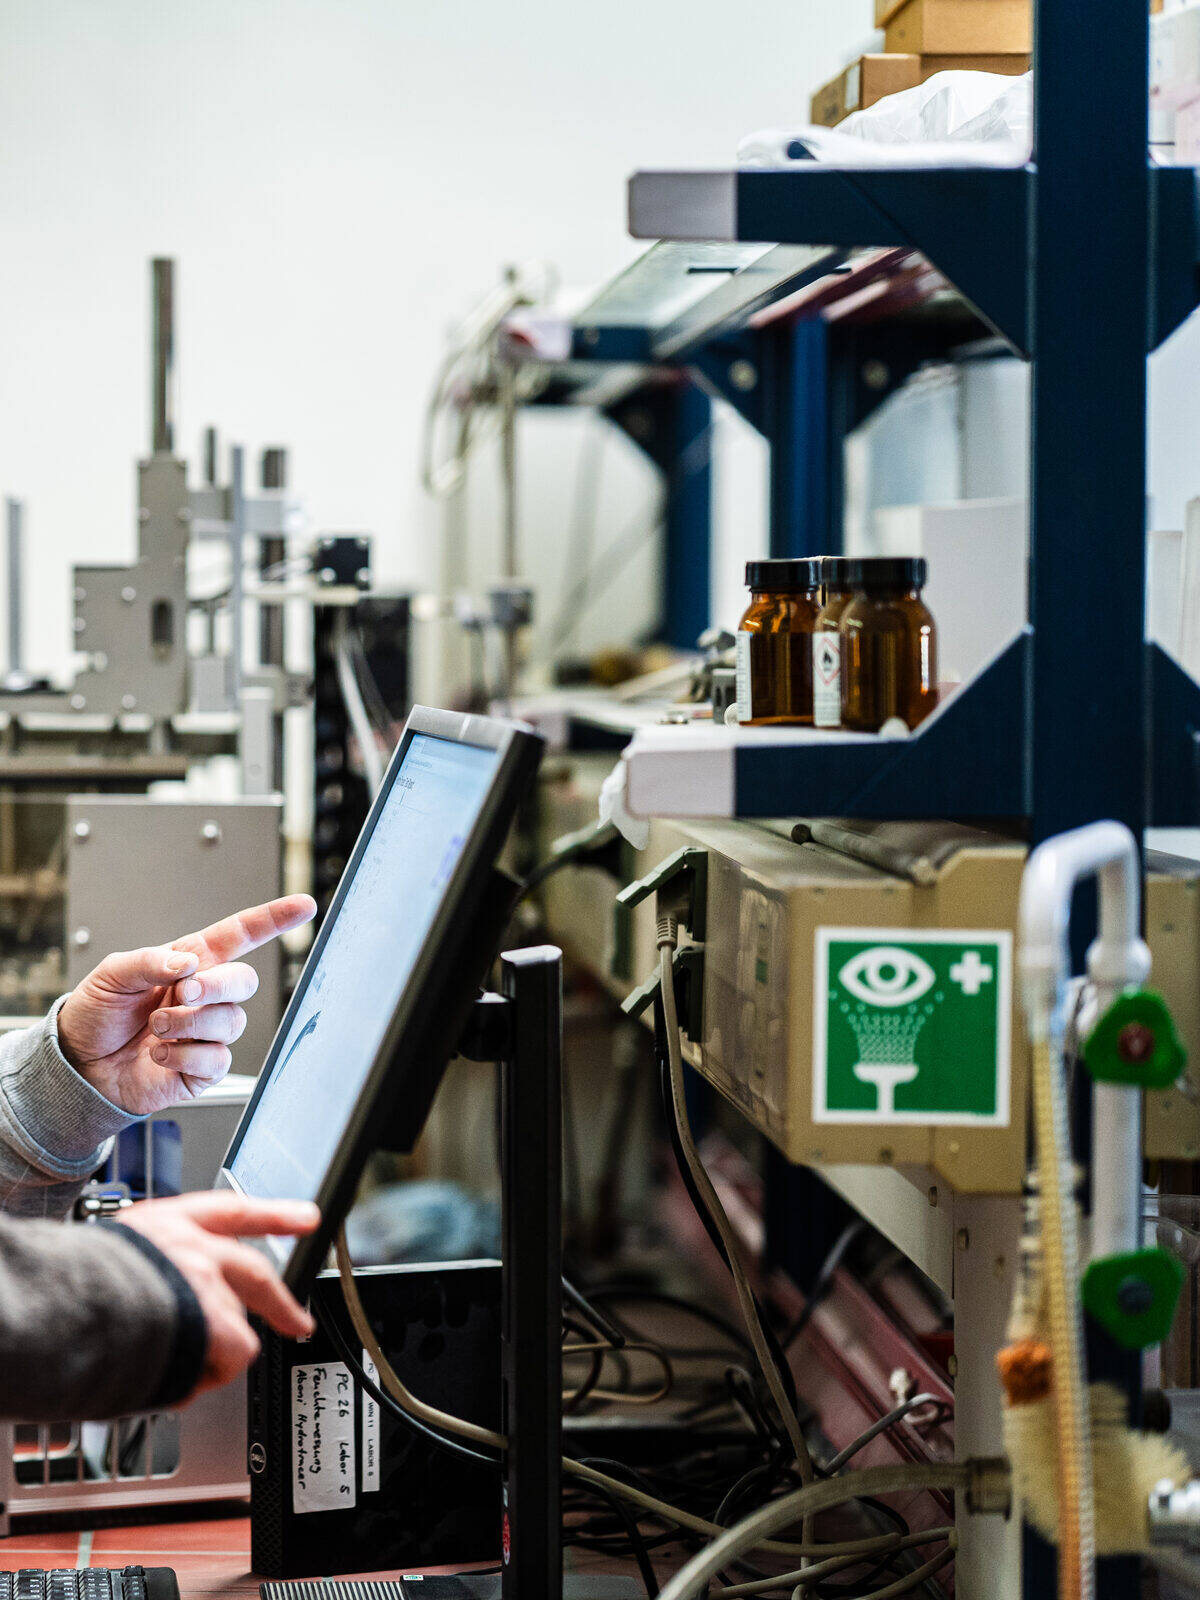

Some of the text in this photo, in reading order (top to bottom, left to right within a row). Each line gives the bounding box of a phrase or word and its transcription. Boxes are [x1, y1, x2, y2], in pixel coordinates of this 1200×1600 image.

[294, 1370, 308, 1490] Aboni Hydrotracer
[336, 1373, 351, 1495] PC 26 Labor 5
[367, 1438, 375, 1468] LABOR
